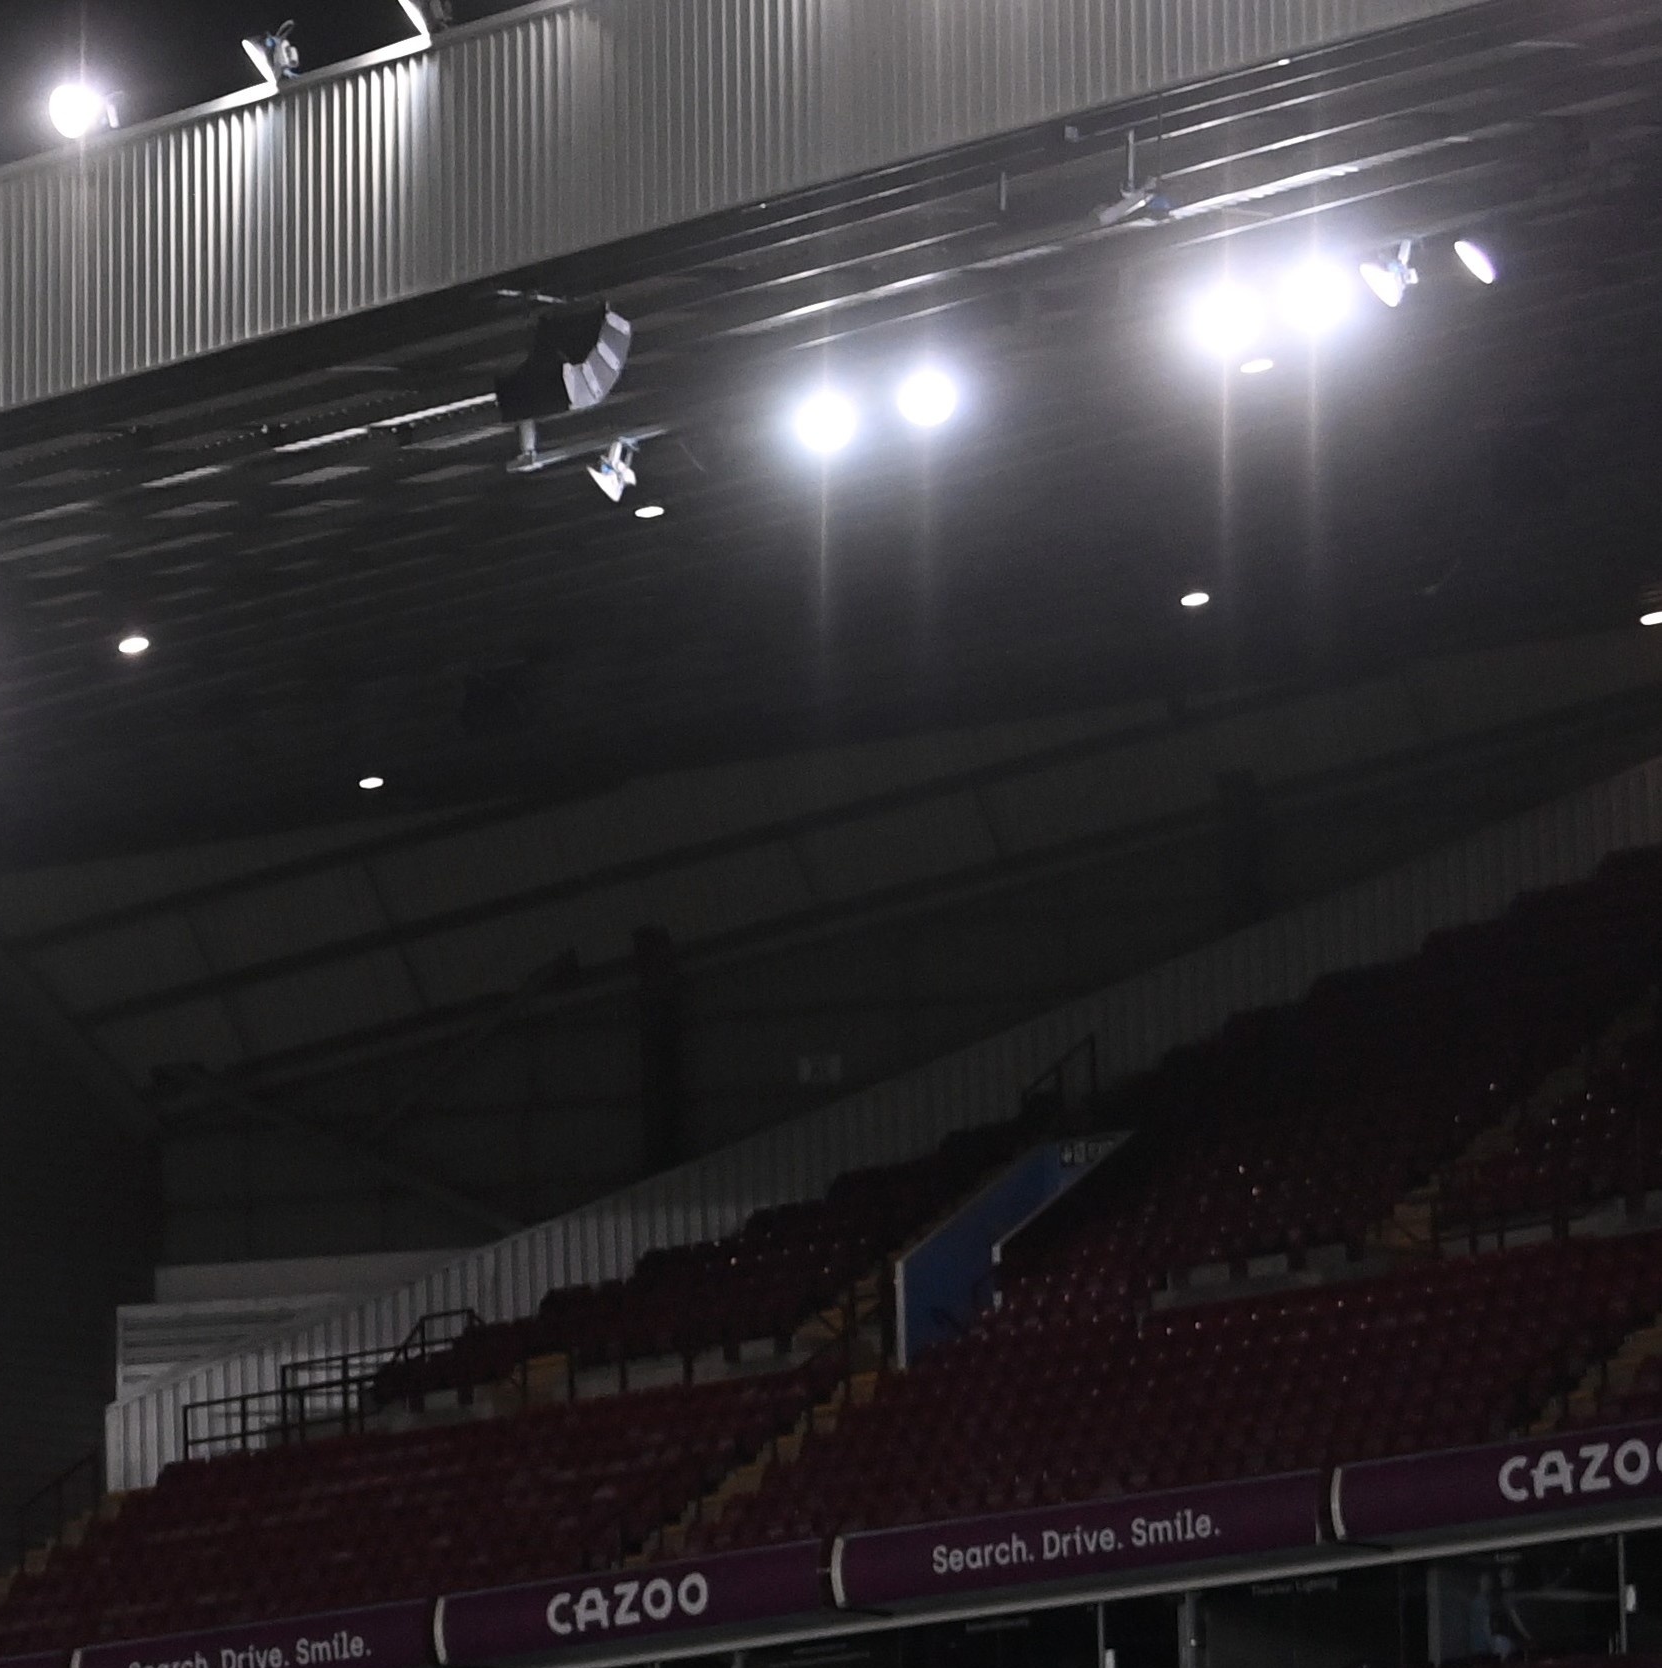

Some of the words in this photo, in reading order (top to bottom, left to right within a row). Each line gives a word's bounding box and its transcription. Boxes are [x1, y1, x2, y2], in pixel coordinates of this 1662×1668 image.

[1497, 1439, 1662, 1501] CAZO
[932, 1534, 1034, 1575] Search.
[1042, 1525, 1124, 1562] Drive.
[1130, 1508, 1220, 1549] Smile.
[546, 1572, 709, 1636] CAZOO
[295, 1630, 372, 1666] Smile.
